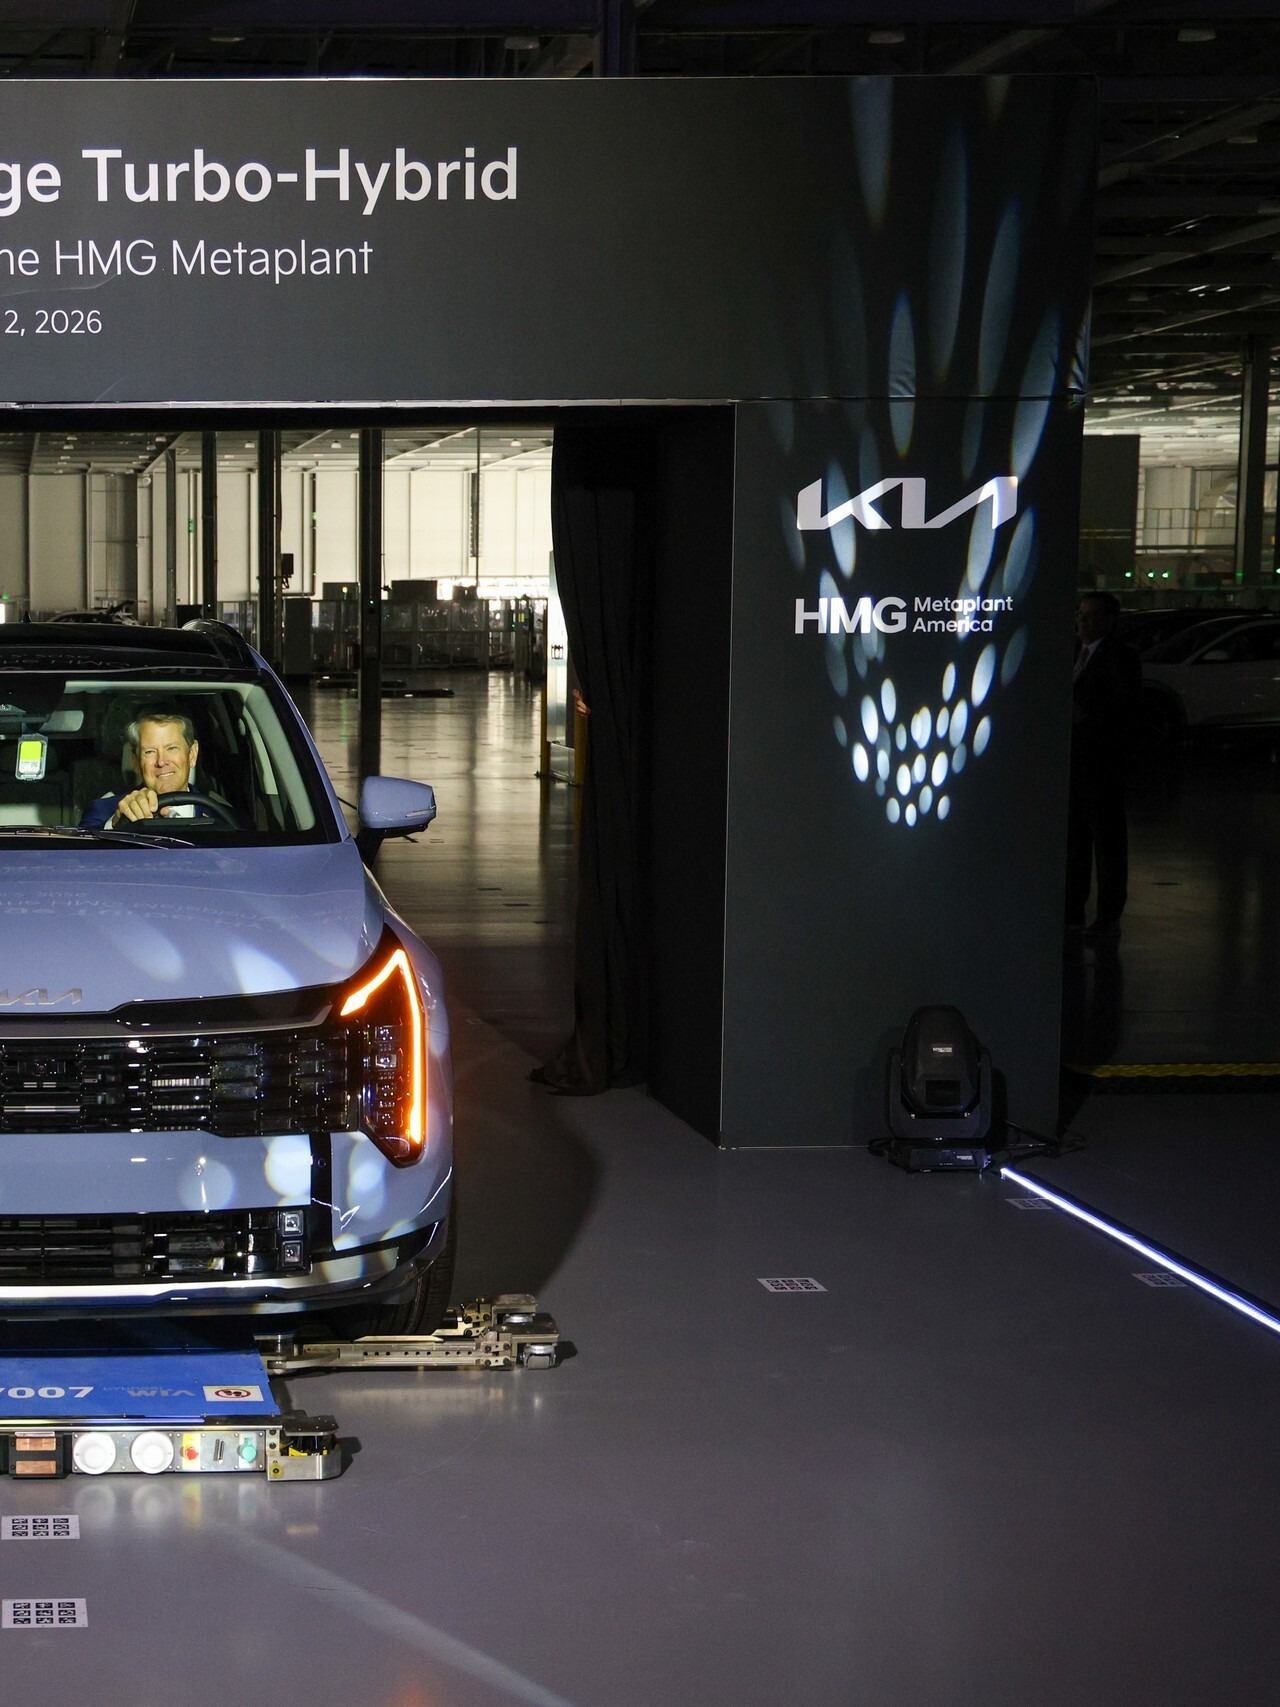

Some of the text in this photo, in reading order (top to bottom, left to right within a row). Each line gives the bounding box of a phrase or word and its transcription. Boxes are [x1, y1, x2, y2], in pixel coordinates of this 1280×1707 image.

[82, 147, 519, 217] Turbo-Hybrid
[55, 240, 158, 277] HMG
[172, 240, 375, 286] Metaplant
[4, 309, 27, 339] 2,
[36, 309, 104, 336] 2026
[797, 476, 1018, 530] KIA
[795, 596, 1014, 634] HMG Metaplant
[912, 616, 993, 633] America
